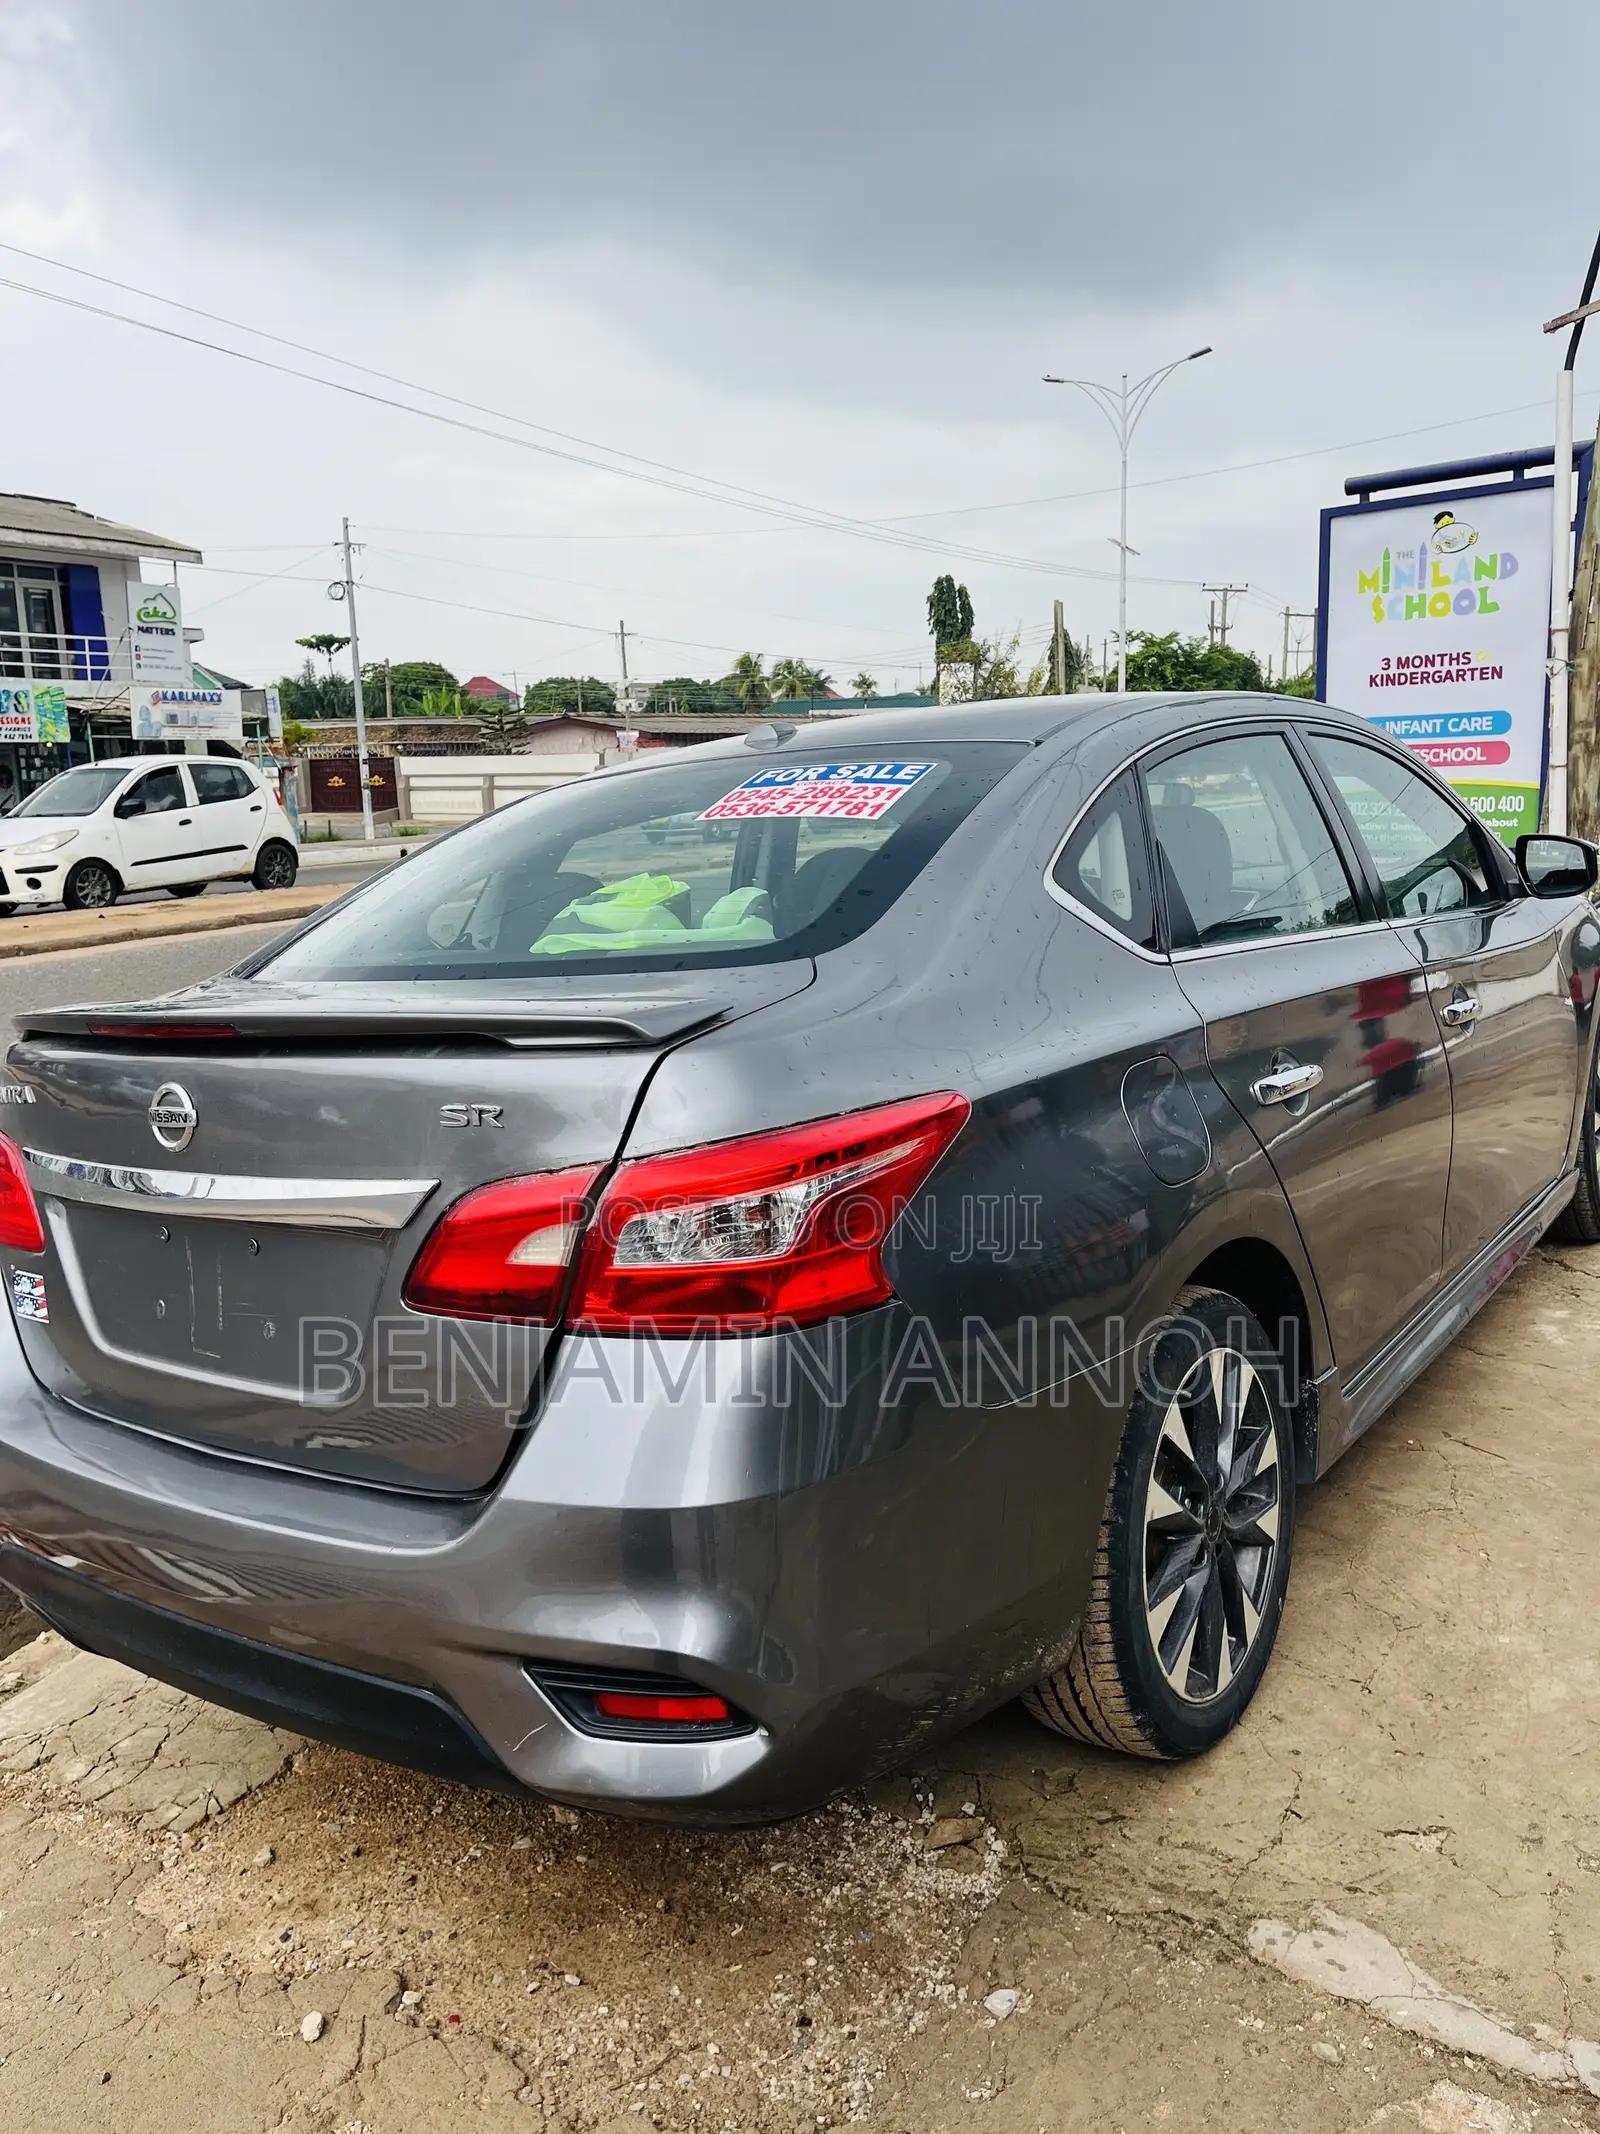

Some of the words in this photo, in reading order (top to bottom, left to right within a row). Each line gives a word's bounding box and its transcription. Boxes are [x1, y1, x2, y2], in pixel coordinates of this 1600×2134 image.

[1396, 551, 1415, 560] THE
[1358, 542, 1519, 594] MINILAND
[1372, 586, 1500, 624] SCHOOL
[137, 626, 176, 636] MATTERS
[1381, 658, 1391, 671] 3
[1396, 652, 1471, 670] MONTHS
[1369, 666, 1503, 687] KINDERGARTEN
[162, 690, 222, 703] KARLMAXX
[1385, 719, 1444, 734] INFANT
[1448, 716, 1493, 732] CARE
[753, 767, 828, 785] FOR
[829, 764, 926, 780] SALE
[723, 786, 903, 803] 0245-288231
[704, 801, 886, 818] 0536-571781
[1498, 795, 1524, 812] 400
[150, 1110, 188, 1124] NISSAN
[440, 1103, 504, 1128] SR
